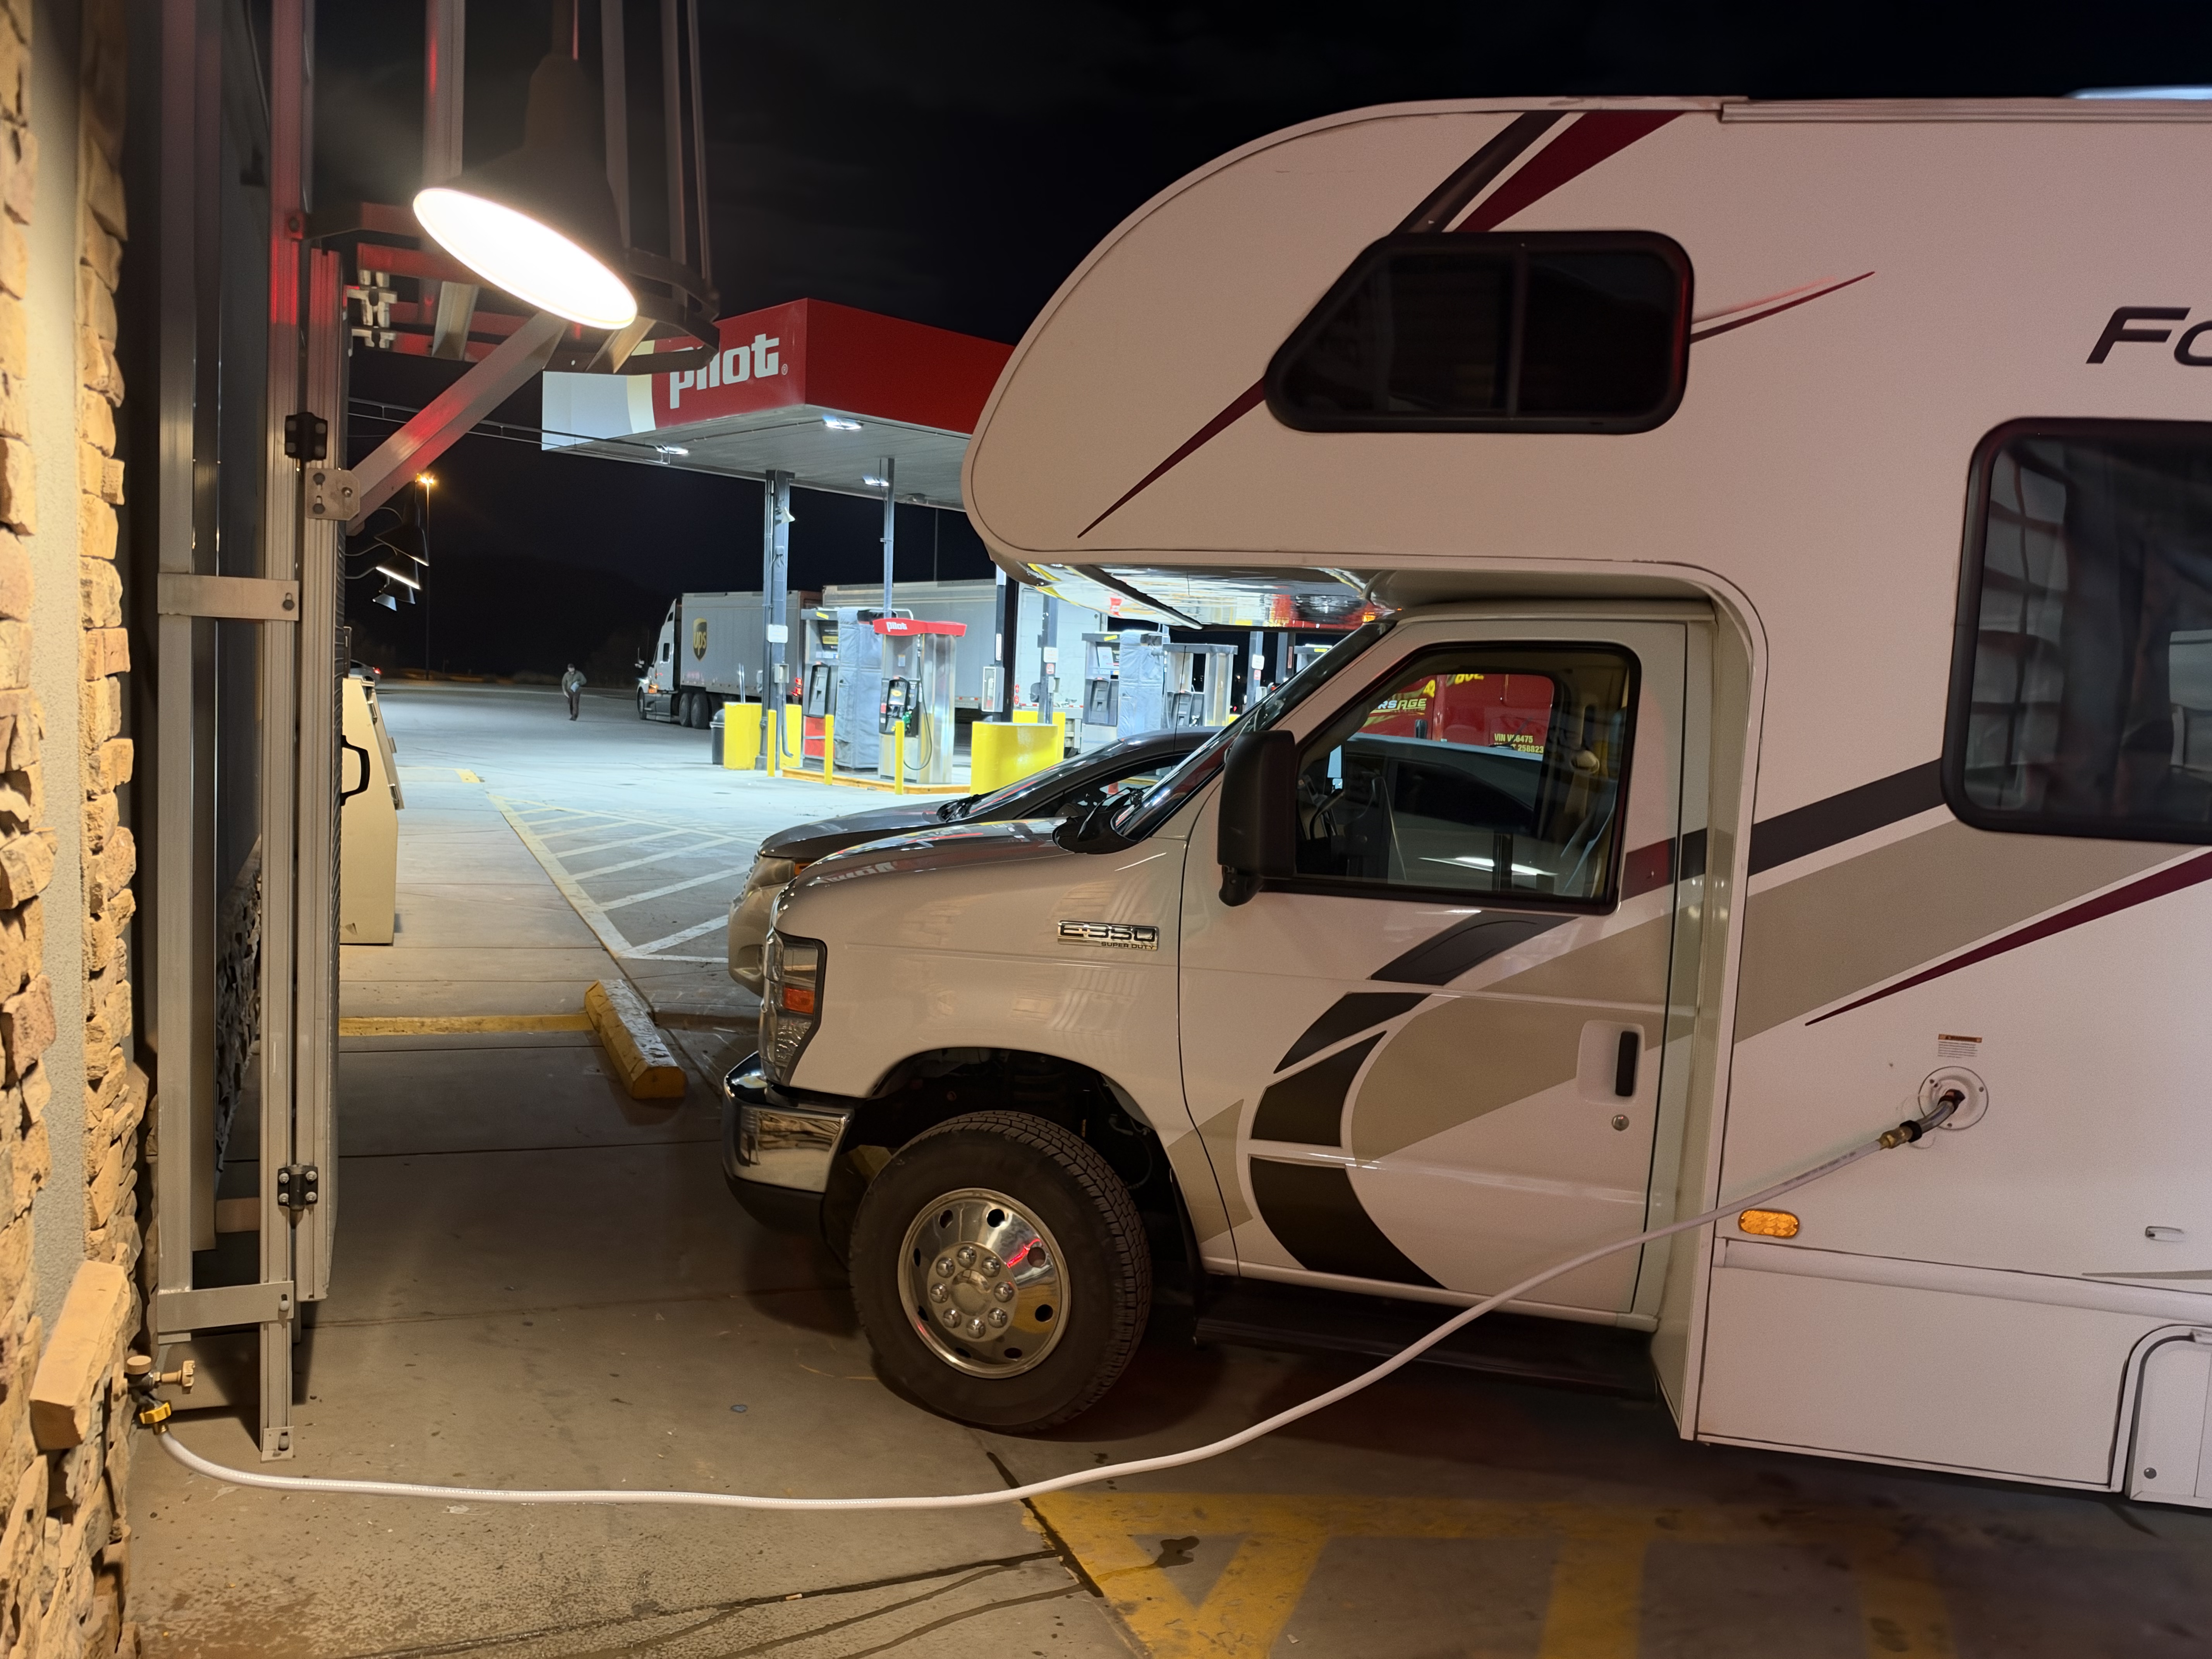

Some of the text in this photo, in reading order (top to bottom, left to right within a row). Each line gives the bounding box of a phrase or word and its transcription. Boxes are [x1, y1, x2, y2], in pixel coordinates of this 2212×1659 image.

[886, 622, 907, 632] pilot
[1377, 698, 1427, 710] RSAGE
[1494, 733, 1506, 742] VIN
